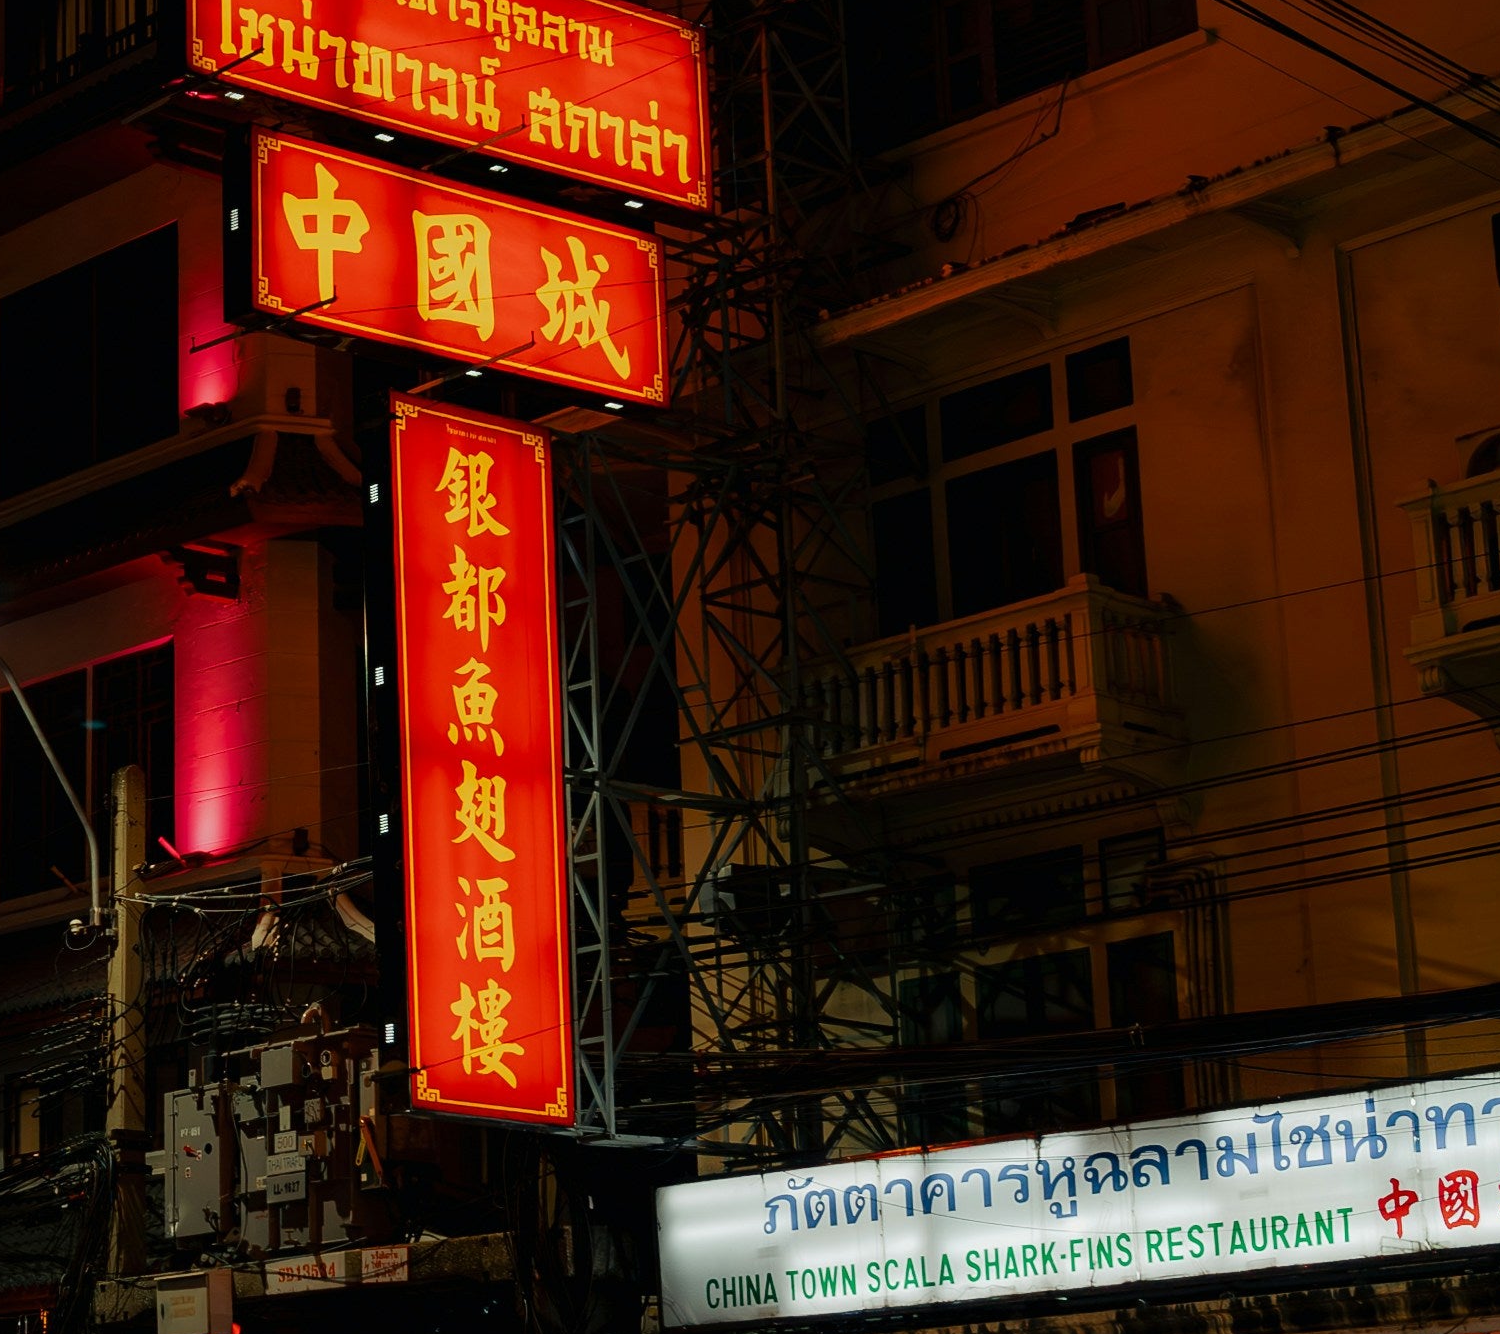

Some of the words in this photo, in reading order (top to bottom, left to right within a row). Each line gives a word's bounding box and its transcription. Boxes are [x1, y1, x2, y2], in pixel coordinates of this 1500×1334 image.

[527, 86, 692, 185] สกาล่า
[281, 161, 632, 381] 中國城
[434, 445, 527, 1090] 銀都魚翅酒樓
[704, 1270, 779, 1310] CHINA
[784, 1263, 857, 1302] TOWN
[866, 1252, 955, 1294] SCALA
[965, 1235, 1133, 1283] SHARK-FINS
[1145, 1207, 1355, 1265] RESTAURANT
